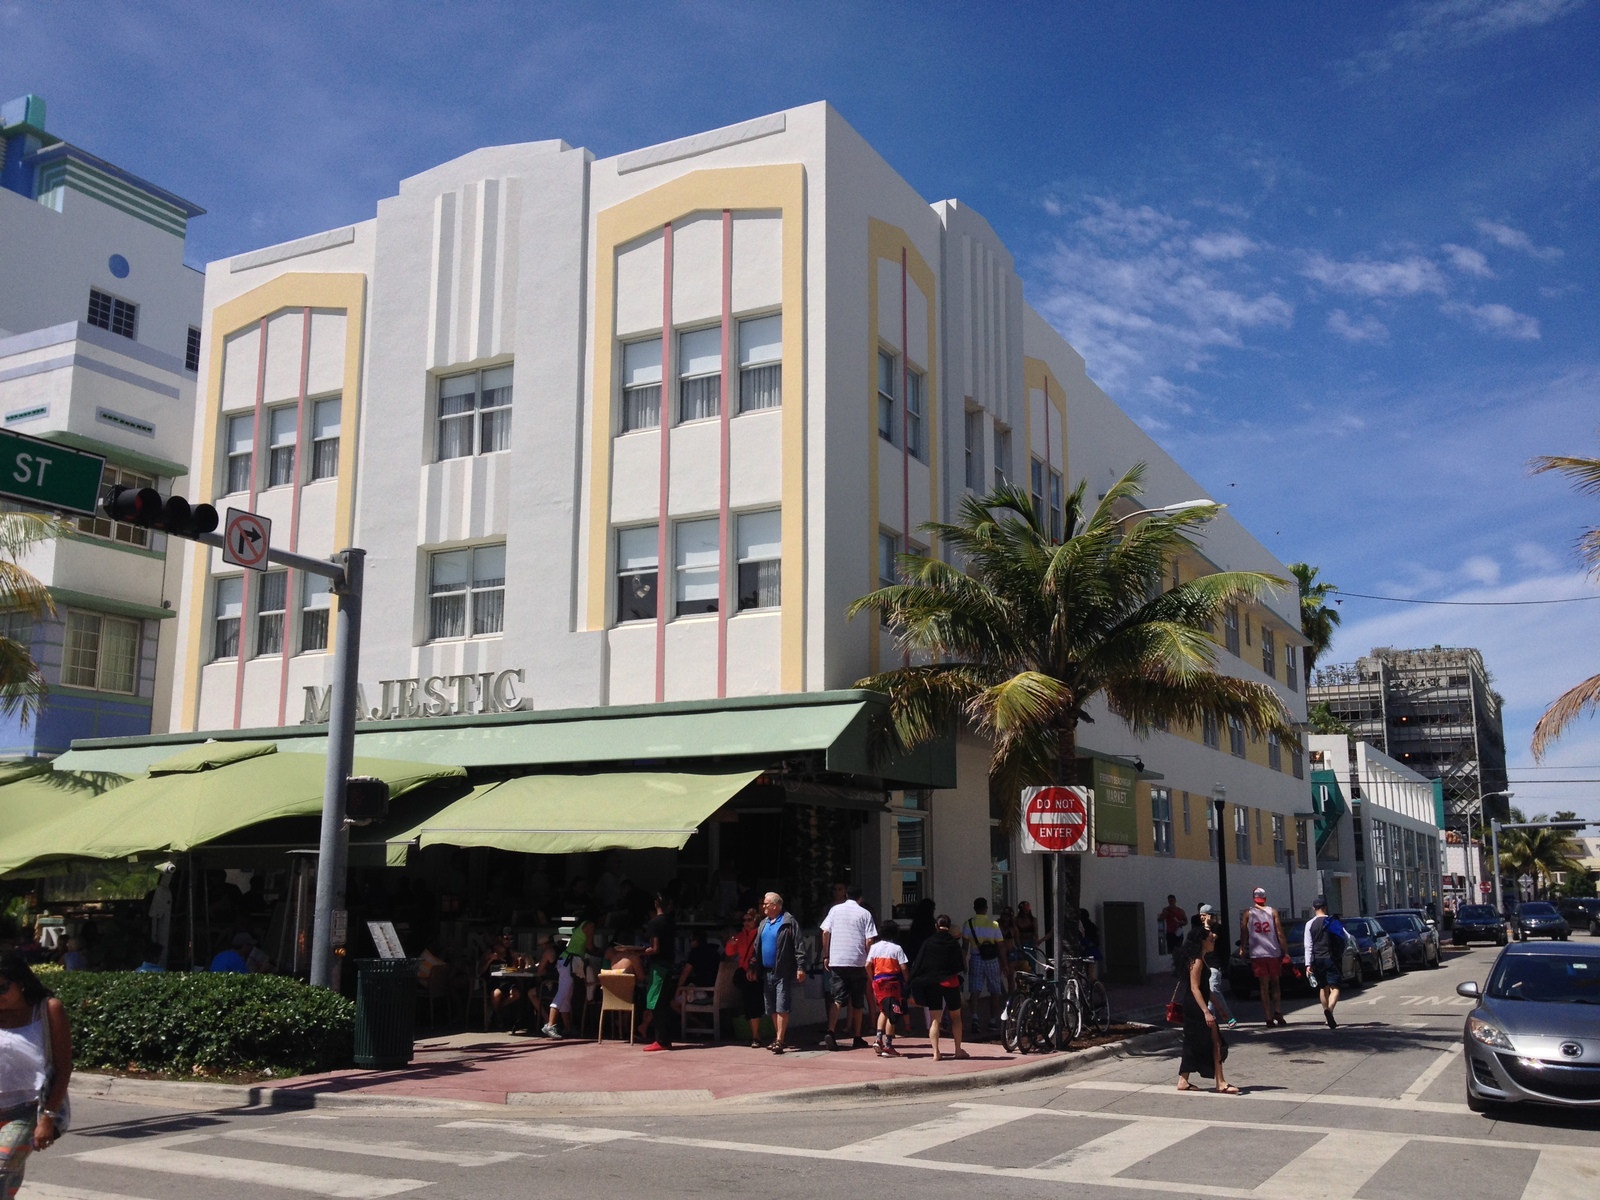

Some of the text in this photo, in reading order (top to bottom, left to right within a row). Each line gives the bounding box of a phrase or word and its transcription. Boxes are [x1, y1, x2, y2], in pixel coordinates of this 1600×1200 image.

[12, 452, 53, 487] ST
[1106, 789, 1127, 804] MARKET
[1036, 799, 1075, 809] DO NOT
[1039, 827, 1073, 838] ENTER
[1253, 921, 1271, 934] 32
